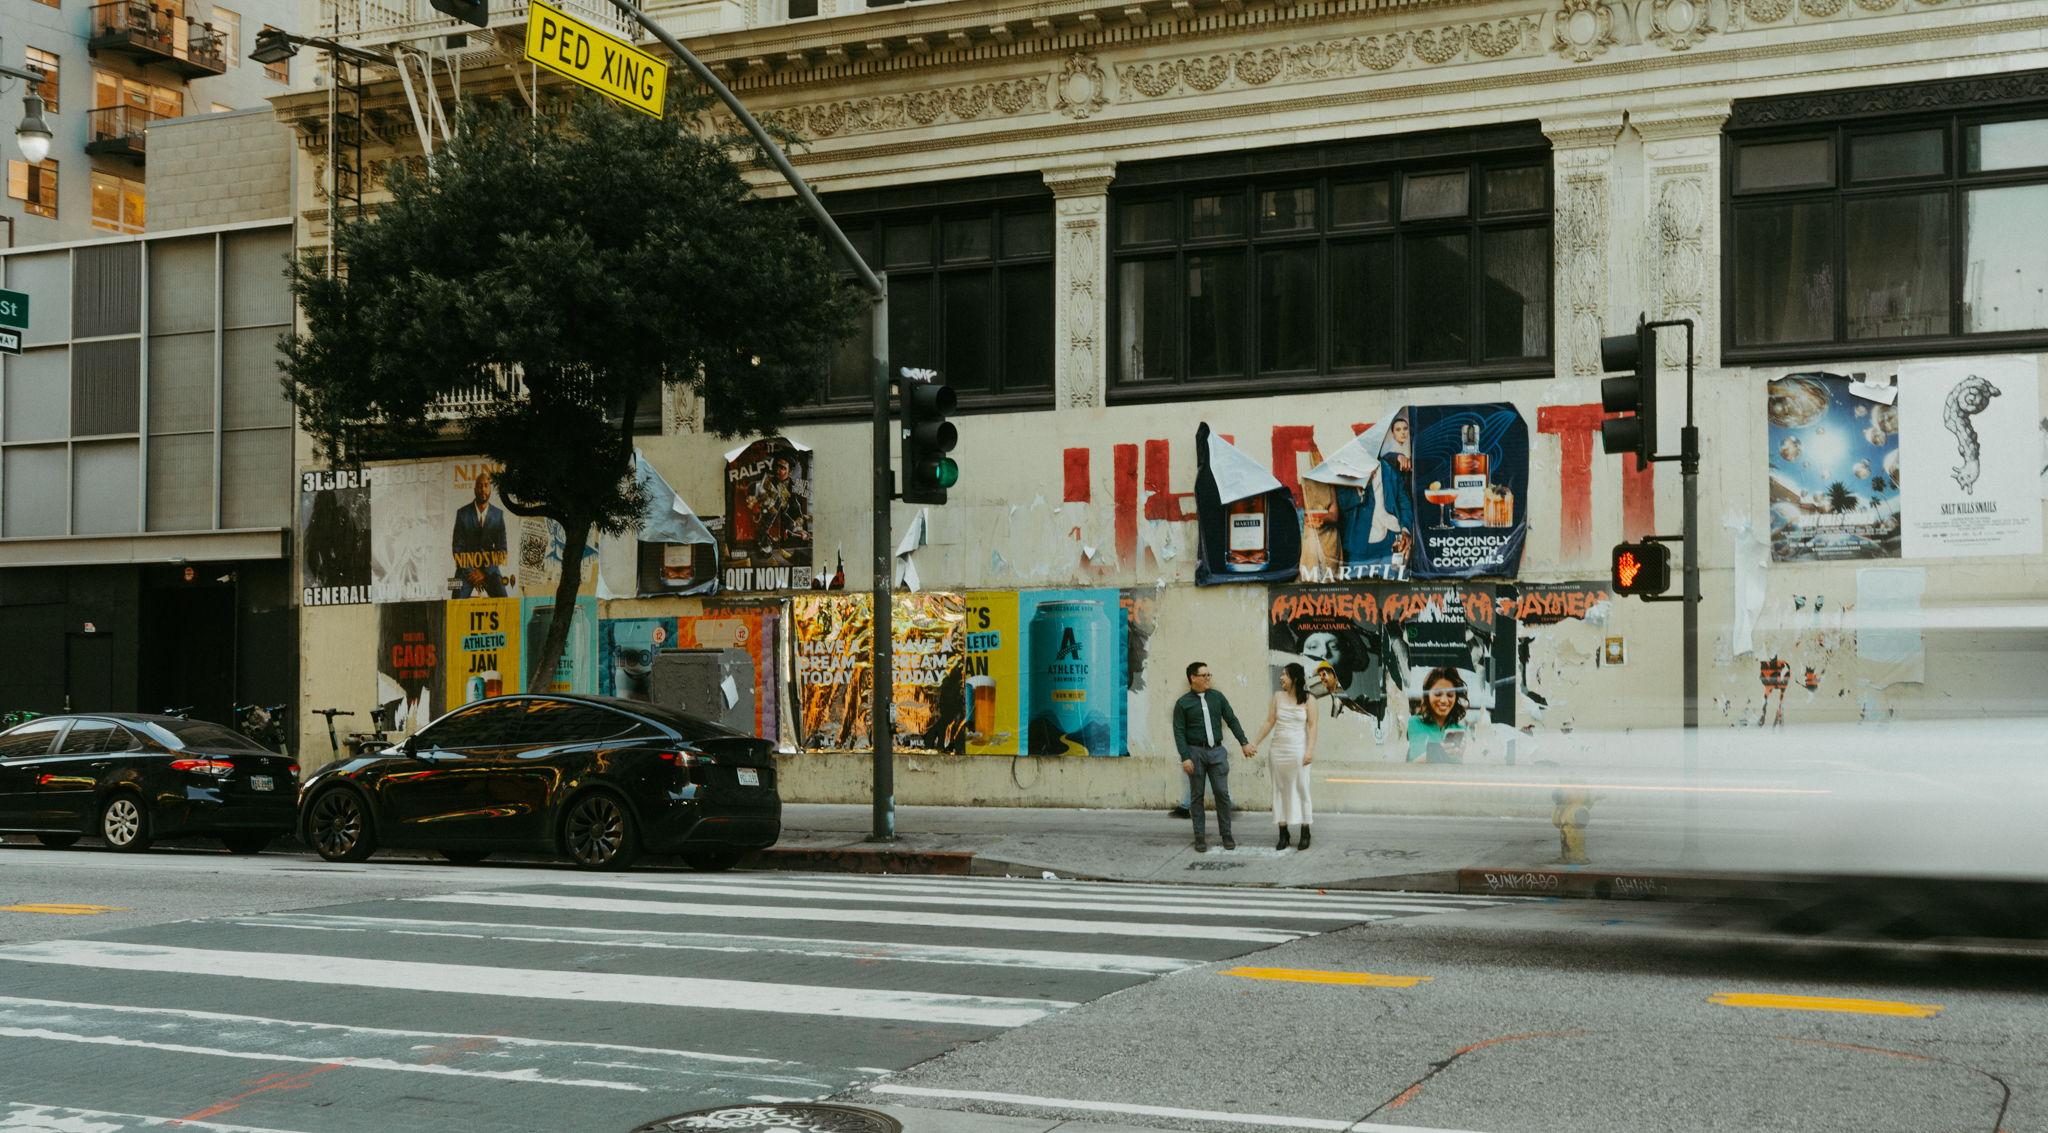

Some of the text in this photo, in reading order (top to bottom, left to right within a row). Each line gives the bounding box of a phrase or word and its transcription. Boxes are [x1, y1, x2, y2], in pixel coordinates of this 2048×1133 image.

[540, 17, 655, 101] PED XING
[0, 300, 18, 317] St
[729, 458, 775, 483] RALFY
[1941, 500, 1997, 515] SALT KILLS SNAILS
[1428, 535, 1511, 548] SHOCKINGLY
[1442, 546, 1498, 557] SMOOTH
[454, 552, 491, 569] NINO'S
[1433, 554, 1504, 568] COCKTAILS
[725, 567, 790, 591] OUT NOW
[1301, 564, 1410, 583] MARTELL
[1271, 592, 1378, 626] MAYHEM
[470, 611, 499, 631] IT'S
[1298, 623, 1351, 631] ABRACADABRA
[464, 635, 505, 651] ATHLETIC
[803, 640, 845, 654] HAVE
[849, 640, 861, 654] A
[892, 638, 953, 653] HAVE A
[967, 634, 998, 649] LETIC
[469, 653, 498, 674] JAN
[799, 655, 857, 670] DREAM
[965, 656, 989, 676] AN
[1048, 664, 1089, 675] ATHLETIC
[802, 671, 853, 685] TODAY
